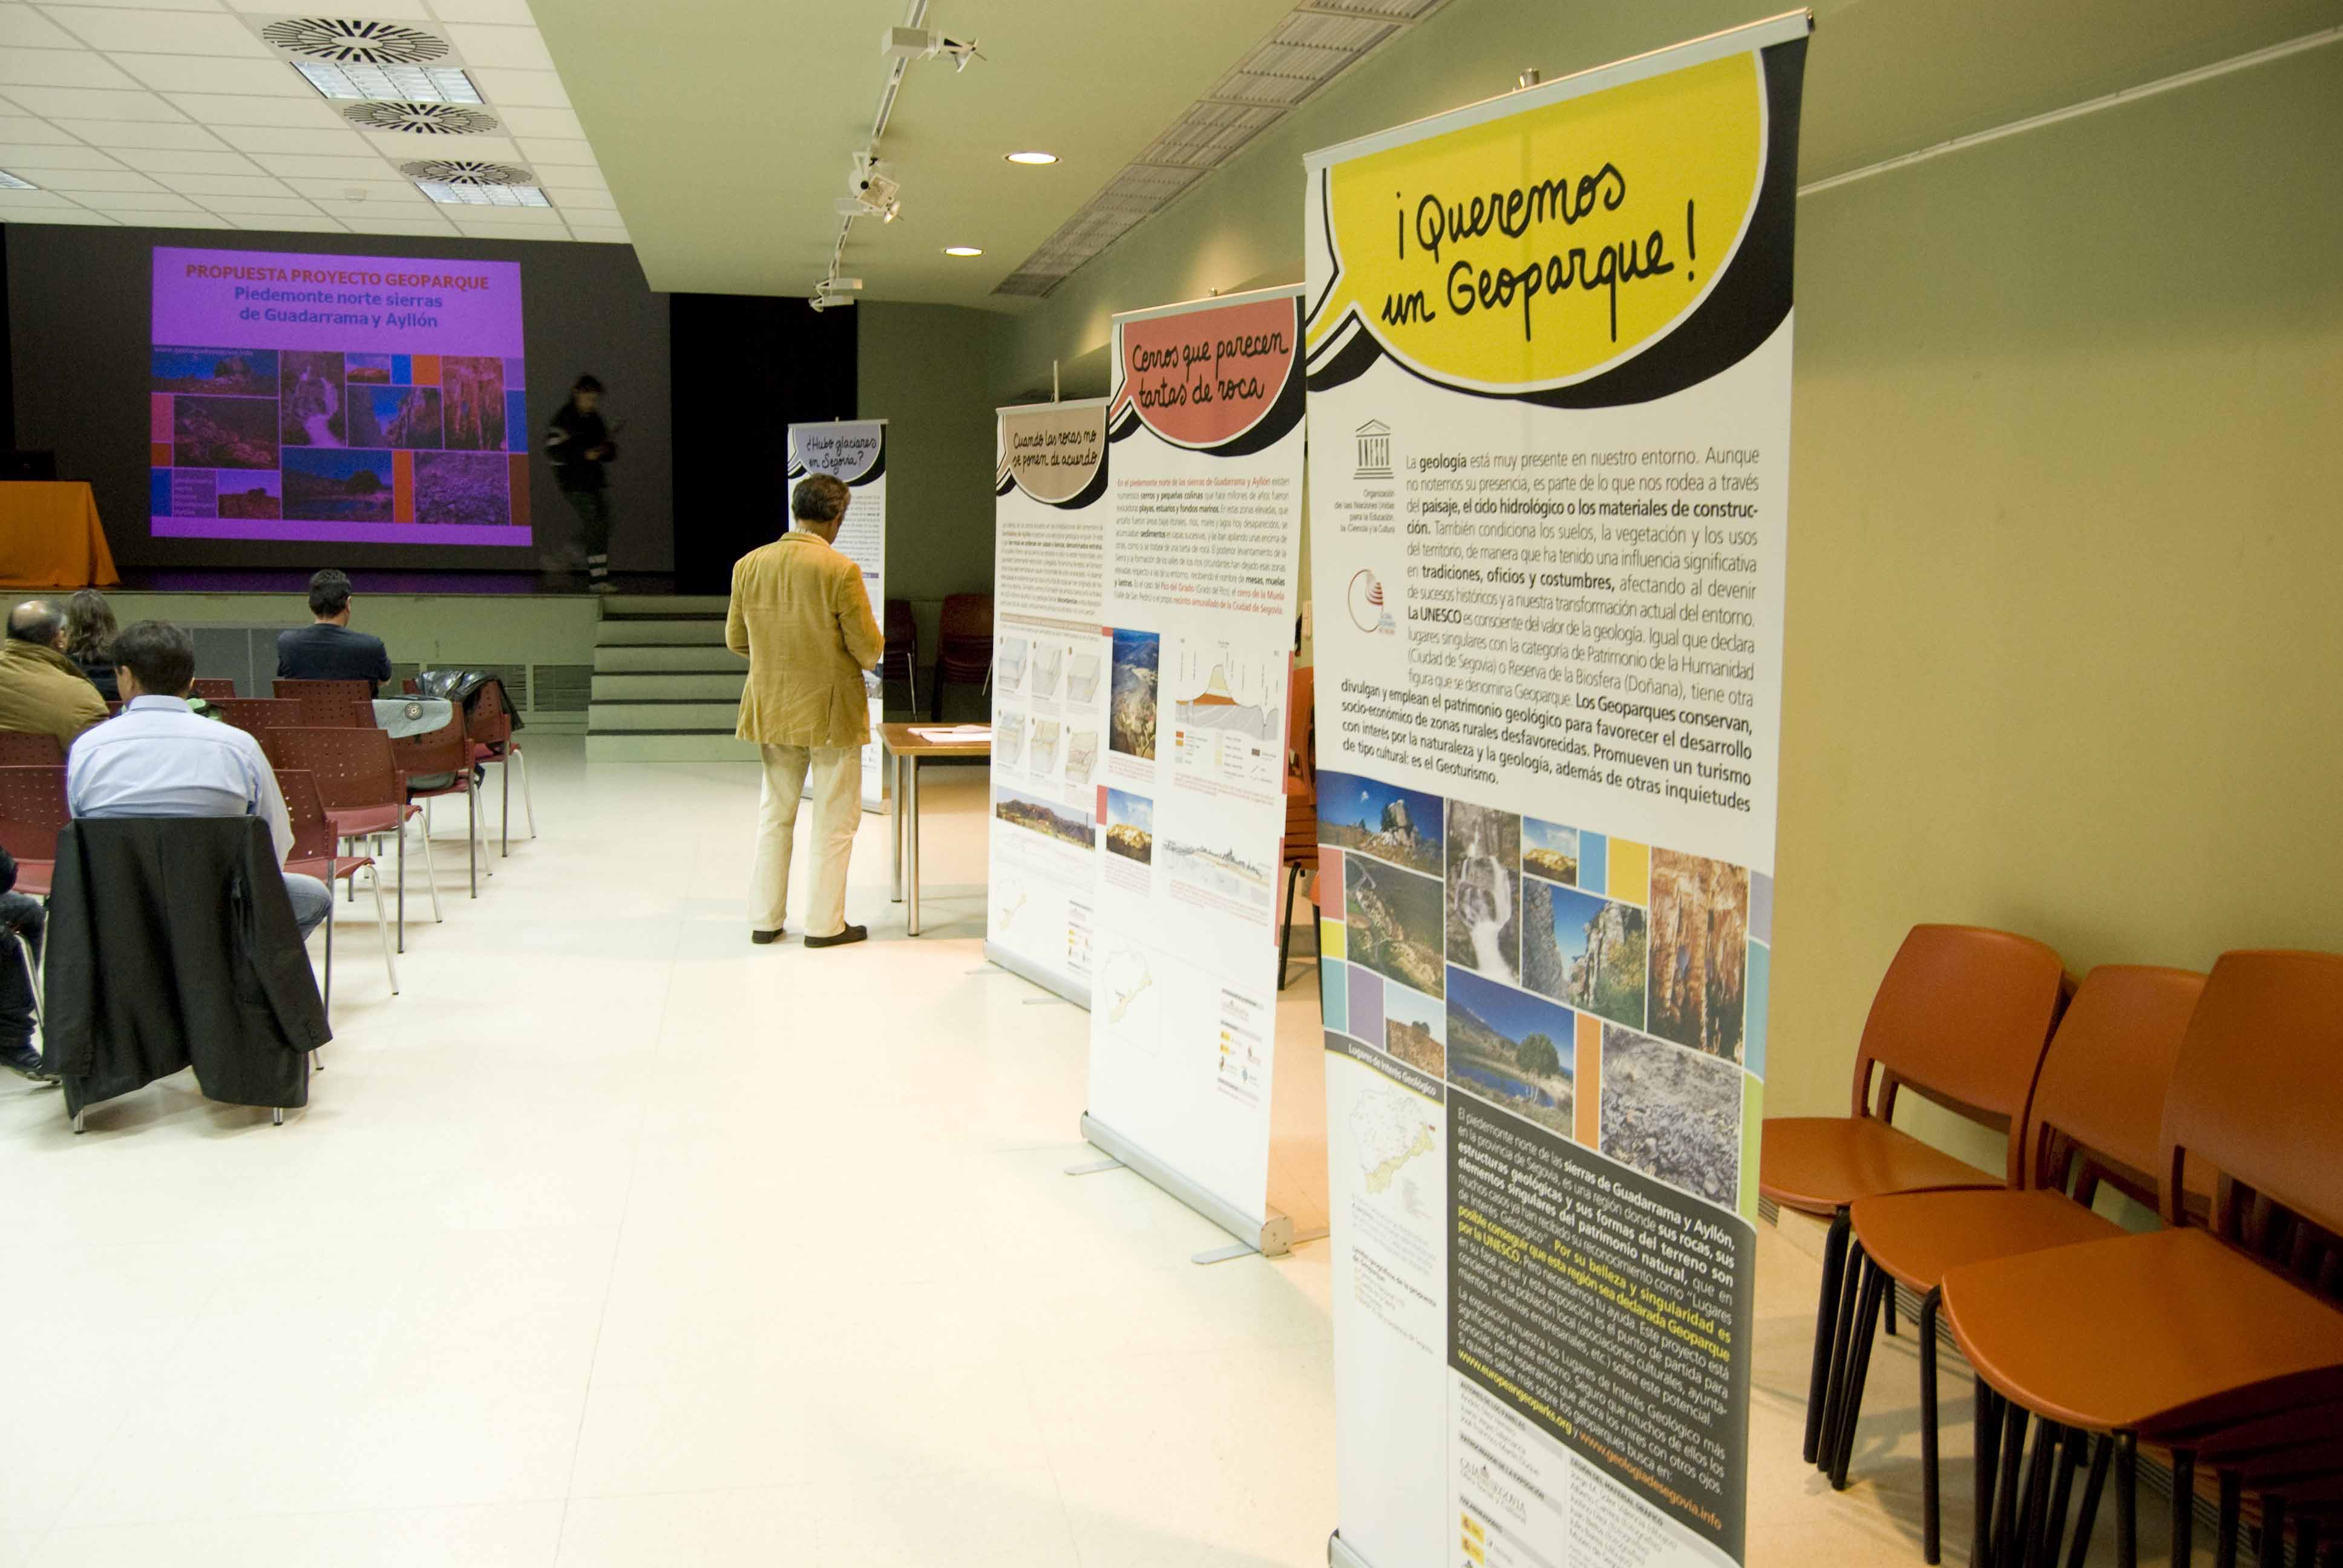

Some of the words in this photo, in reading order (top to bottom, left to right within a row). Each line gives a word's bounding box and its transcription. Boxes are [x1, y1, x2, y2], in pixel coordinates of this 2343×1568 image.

[186, 264, 288, 281] PROPUESTA
[291, 269, 381, 285] PROYECTO
[385, 273, 490, 291] GEOPARQUE
[234, 286, 333, 304] Piedemonte
[336, 290, 382, 305] norte
[386, 293, 443, 308] sierras
[1382, 290, 1435, 325] un
[239, 307, 261, 321] de
[264, 309, 368, 325] Guadarrama
[372, 316, 381, 329] y
[385, 312, 437, 328] Ayllón
[1132, 344, 1179, 372] Cerros
[1183, 341, 1211, 382] que
[1216, 332, 1288, 381] parecen
[1139, 377, 1187, 408] tartas
[1192, 374, 1213, 405] de
[1217, 377, 1265, 400] roca
[835, 436, 877, 457] glaciares
[1013, 431, 1044, 449] Cuando
[1045, 429, 1057, 446] las
[1058, 430, 1082, 445] rocas
[1083, 429, 1096, 443] no
[809, 459, 819, 468] en
[1012, 455, 1021, 468] se
[1023, 454, 1049, 474] ponen
[1050, 451, 1060, 466] de
[1061, 448, 1098, 466] acuerdo
[1406, 456, 1417, 469] La
[1420, 454, 1466, 472] geología
[1470, 452, 1490, 468] está
[1493, 456, 1518, 471] muy
[1521, 452, 1568, 471] presente
[1571, 453, 1586, 466] en
[1591, 450, 1637, 466] nuestro
[1642, 449, 1699, 465] entorno.
[1705, 446, 1759, 468] Aunque
[1406, 498, 1420, 513] del
[1423, 498, 1460, 517] paisaje,
[1463, 498, 1472, 513] el
[1500, 498, 1564, 518] hidrológico
[1567, 503, 1575, 515] o
[1579, 498, 1596, 515] los
[1599, 499, 1668, 516] materiales
[1671, 499, 1689, 517] de
[1693, 502, 1757, 518] construc-
[1407, 520, 1430, 534] ción.
[1435, 520, 1475, 536] También
[1478, 521, 1536, 538] condiciona
[1540, 522, 1555, 539] los
[1558, 523, 1596, 542] suelos,
[1602, 523, 1611, 541] la
[1616, 526, 1686, 546] vegetación
[1692, 531, 1699, 548] y
[1705, 526, 1723, 544] los
[1729, 531, 1757, 546] usos
[1407, 566, 1418, 577] en
[1422, 564, 1483, 583] tradiciones,
[1487, 567, 1525, 584] oficios
[1529, 573, 1536, 589] y
[1541, 572, 1614, 592] costumbres,
[1620, 574, 1685, 595] afectando
[1691, 578, 1702, 596] al
[1708, 579, 1756, 599] devenir
[1342, 679, 1380, 699] divulgan
[1380, 689, 1387, 702] y
[1389, 690, 1429, 705] emplean
[1432, 694, 1441, 708] el
[1444, 699, 1502, 718] patrimonio
[1506, 708, 1562, 729] geológico
[1565, 719, 1592, 733] para
[1596, 719, 1659, 743] favorecer
[1663, 730, 1675, 746] el
[1680, 732, 1752, 759] desarrollo
[1576, 693, 1595, 710] Los
[1598, 696, 1676, 722] Geoparques
[1679, 711, 1752, 736] conservan,
[1342, 702, 1412, 724] socio-económico
[1415, 712, 1427, 727] de
[1430, 718, 1460, 733] zonas
[1463, 724, 1498, 740] rurales
[1501, 727, 1589, 756] desfavorecidas.
[1594, 743, 1668, 771] Promueven
[1674, 761, 1692, 774] un
[1697, 762, 1751, 786] turismo
[1343, 738, 1355, 751] de
[1358, 742, 1374, 757] tipo
[1376, 746, 1409, 764] cultural:
[1411, 756, 1422, 768] es
[1424, 756, 1433, 769] el
[1436, 758, 1498, 784] Geoturismo.
[1342, 722, 1360, 733] con
[1363, 725, 1389, 740] interés
[1392, 731, 1406, 744] por
[1409, 731, 1417, 746] la
[1420, 737, 1473, 757] naturaleza
[1477, 748, 1483, 762] y
[1487, 746, 1496, 762] la
[1499, 752, 1552, 774] geología,
[1556, 761, 1602, 783] además
[1607, 769, 1622, 786] de
[1627, 776, 1660, 794] otras
[1666, 780, 1750, 812] inquietudes
[1458, 1142, 1508, 1174] estructuras
[1512, 1169, 1562, 1203] geológicas
[1565, 1197, 1573, 1210] y
[1576, 1202, 1593, 1218] sus
[1596, 1209, 1634, 1240] formas
[1639, 1232, 1656, 1250] del
[1661, 1243, 1707, 1273] terreno
[1712, 1268, 1733, 1287] son
[1458, 1157, 1505, 1189] elementos
[1508, 1181, 1556, 1217] singulares
[1559, 1209, 1575, 1226] del
[1579, 1221, 1637, 1258] patrimonio
[1642, 1253, 1688, 1285] natural,
[1564, 1160, 1598, 1185] sierras
[1598, 1175, 1611, 1192] de
[1613, 1183, 1681, 1224] Guadarrama
[1684, 1217, 1692, 1231] y
[1694, 1220, 1734, 1251] Ayllón,
[1658, 1224, 1677, 1241] sus
[1680, 1234, 1712, 1259] rocas,
[1716, 1250, 1734, 1268] sus
[1555, 1240, 1571, 1258] Por
[1574, 1253, 1585, 1267] su
[1589, 1258, 1626, 1289] belleza
[1630, 1283, 1637, 1296] y
[1640, 1288, 1714, 1334] singularidad
[1718, 1328, 1731, 1343] es
[1580, 1431, 1722, 1531] www.geologiadesegovia.info
